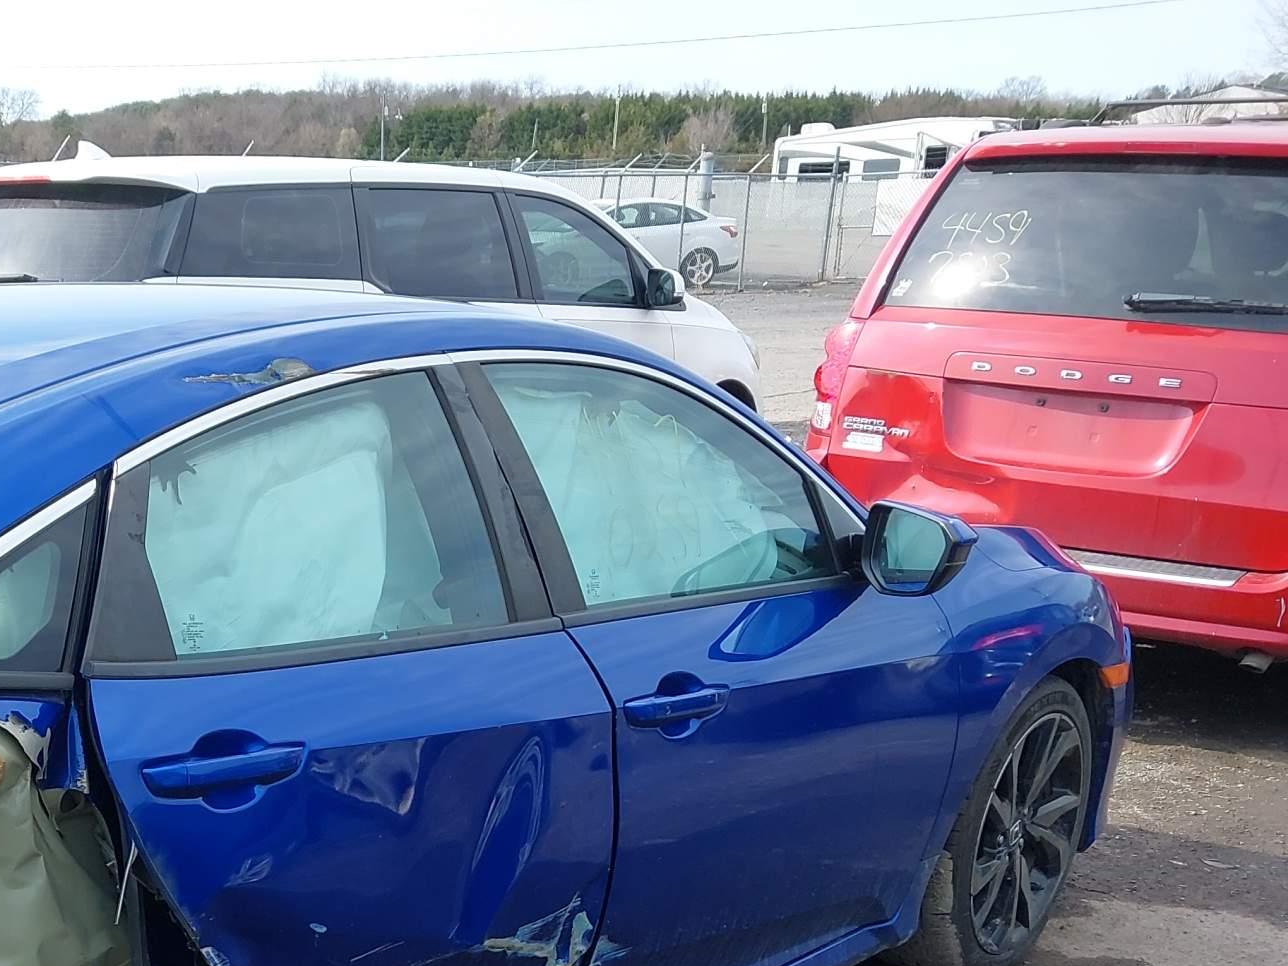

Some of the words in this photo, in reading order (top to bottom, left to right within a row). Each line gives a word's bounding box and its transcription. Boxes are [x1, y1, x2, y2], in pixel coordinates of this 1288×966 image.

[941, 209, 1032, 250] 4459
[971, 360, 1183, 389] DODGE
[842, 422, 910, 438] CARAVAN
[844, 415, 886, 426] GRAND
